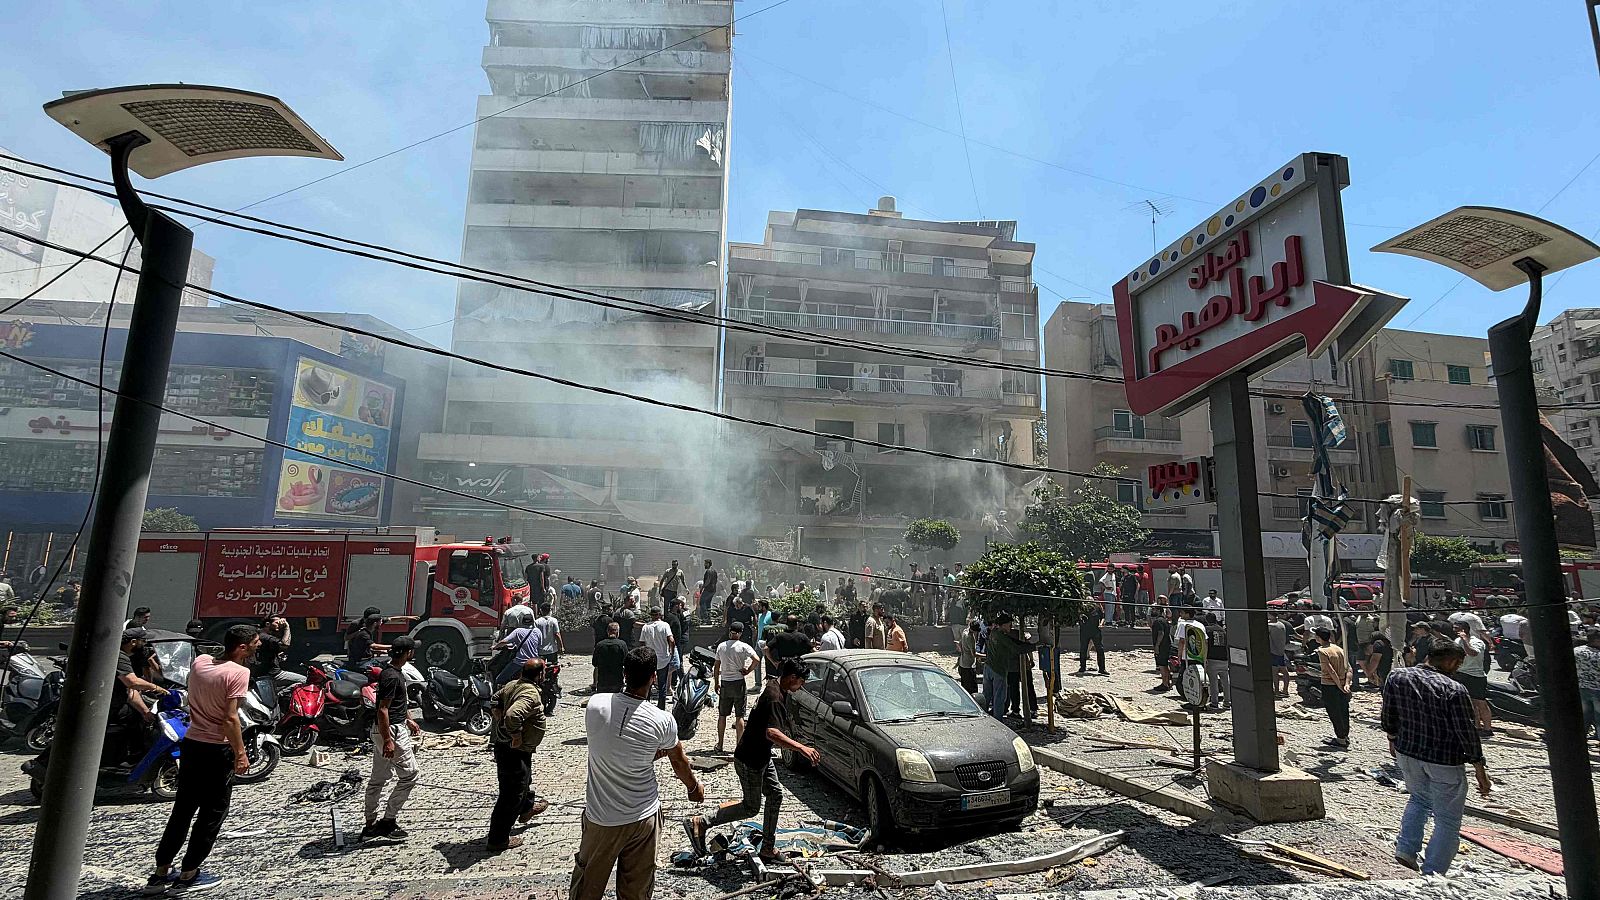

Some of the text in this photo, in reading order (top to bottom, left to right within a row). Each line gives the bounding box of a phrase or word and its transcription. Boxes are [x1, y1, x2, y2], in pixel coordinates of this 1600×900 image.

[1188, 230, 1251, 289] افران
[1149, 235, 1305, 374] ابراهيم
[302, 418, 374, 449] صيفك
[221, 544, 254, 559] الجنوبية
[255, 544, 285, 557] الضاحية
[286, 545, 311, 559] بلديات
[218, 563, 328, 583] فوج إطفاء الضاحية
[284, 587, 326, 601] مركز
